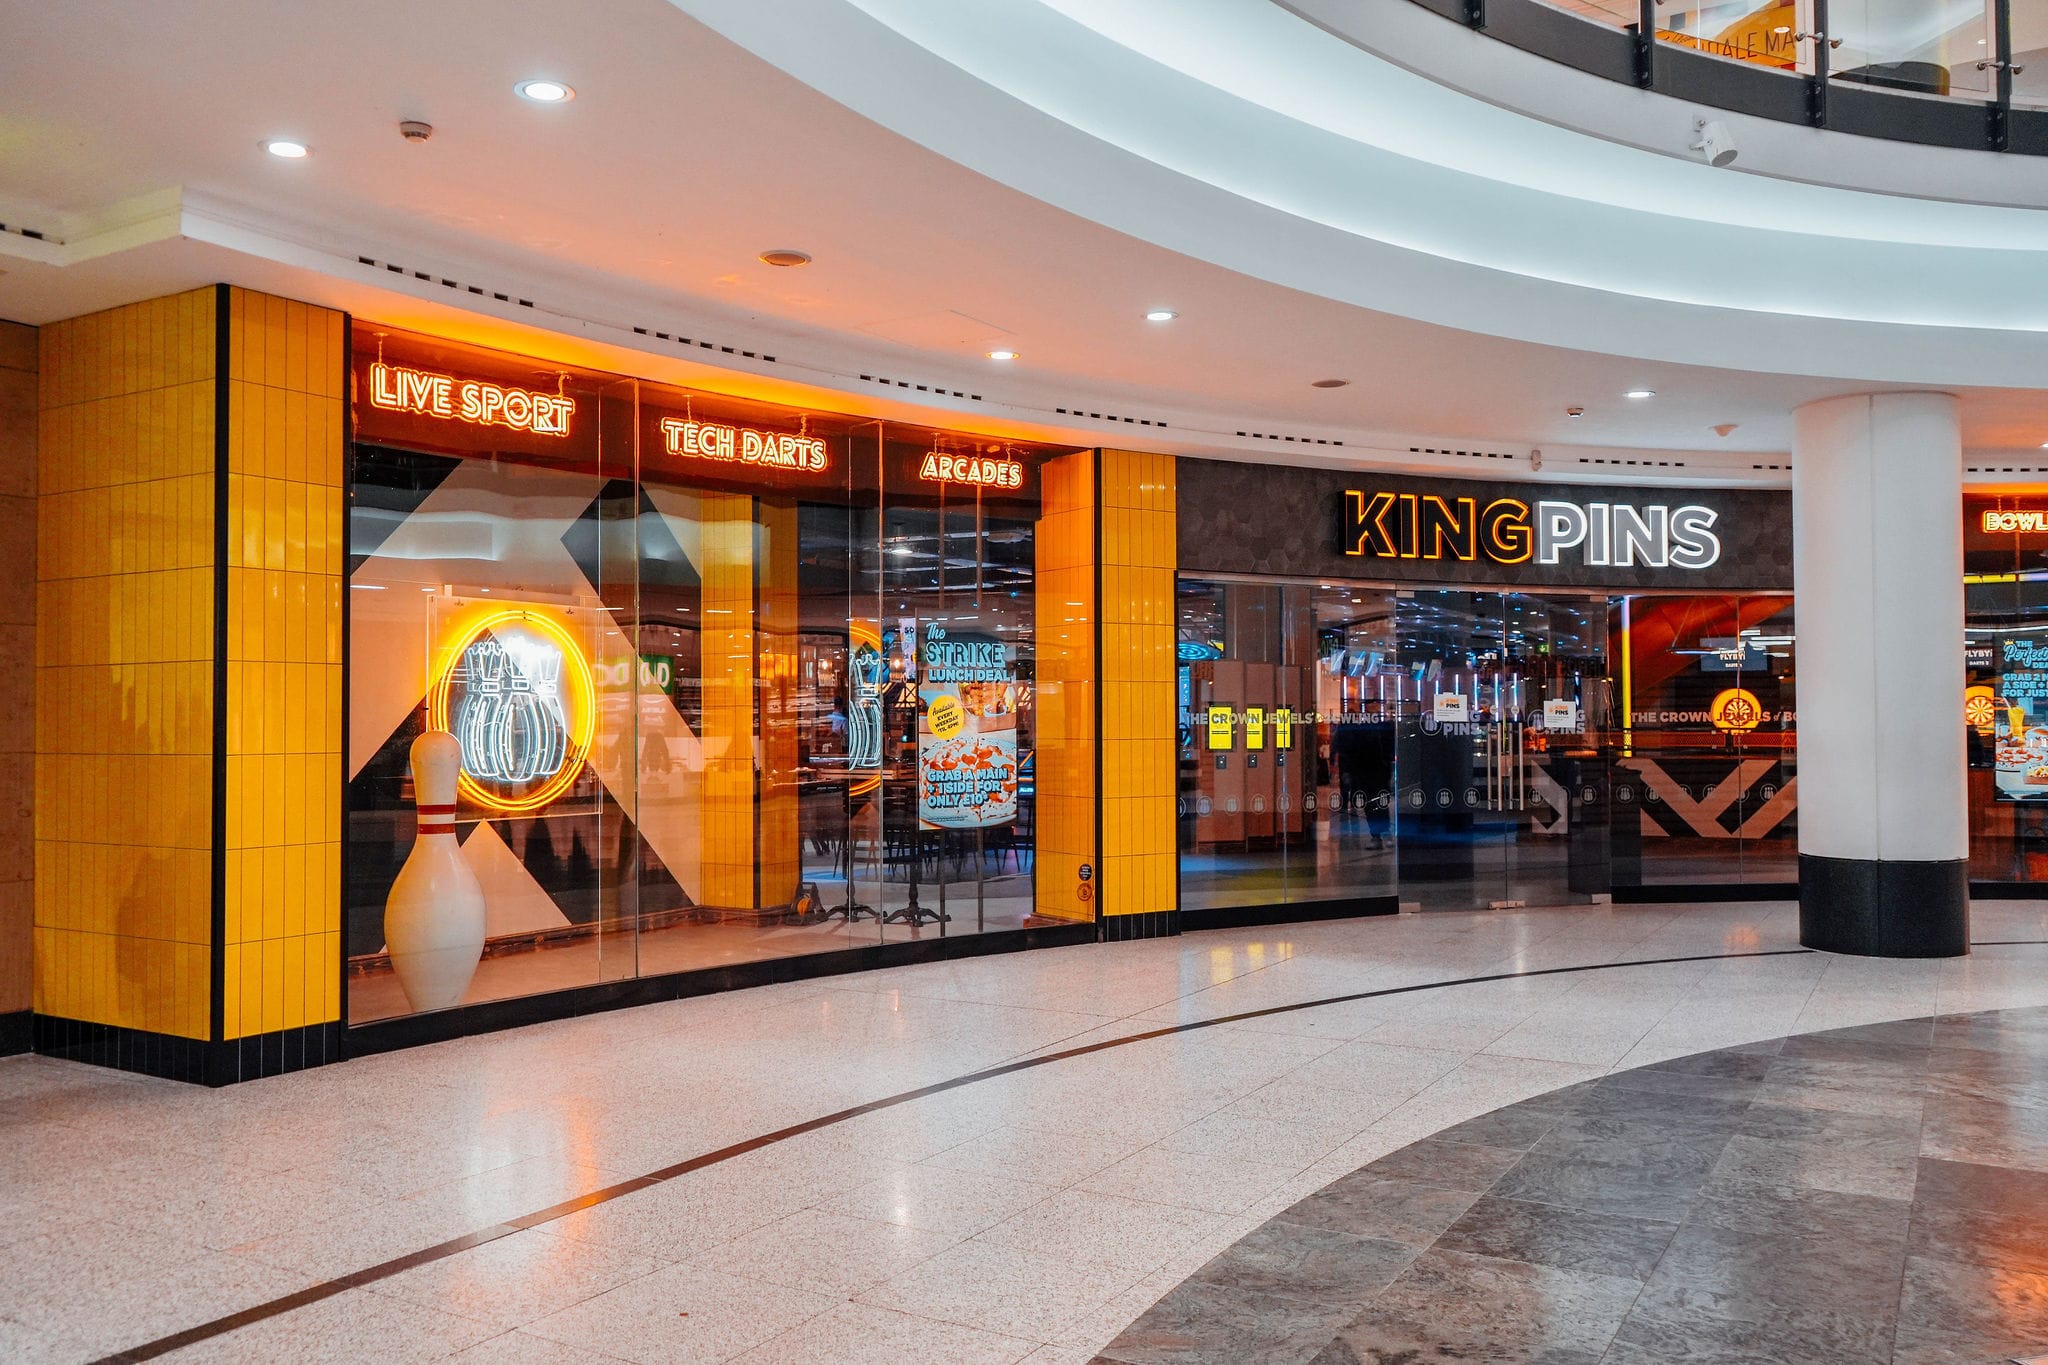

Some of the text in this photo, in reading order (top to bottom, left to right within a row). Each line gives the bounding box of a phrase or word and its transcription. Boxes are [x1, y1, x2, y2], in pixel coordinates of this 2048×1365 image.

[373, 366, 574, 435] LIVE SPORT
[664, 420, 826, 470] TECH DARTS
[922, 454, 1021, 487] ARCADES
[926, 622, 946, 640] The
[926, 641, 1006, 668] STRIKE
[928, 668, 1011, 683] LUNCH DEAL
[2002, 673, 2032, 681] GRAB
[2033, 673, 2041, 681] 2
[2002, 681, 2012, 689] A
[2012, 681, 2037, 689] SIDE
[2002, 689, 2025, 697] FOR
[1211, 713, 1260, 725] CROWN
[1631, 712, 1657, 722] THE
[1660, 712, 1712, 722] CROWN
[1443, 723, 1481, 736] PINS
[927, 768, 1008, 782] GRAB A MAIN
[944, 781, 974, 794] SIDE
[976, 780, 1002, 793] FOR
[927, 794, 959, 808] ONLY
